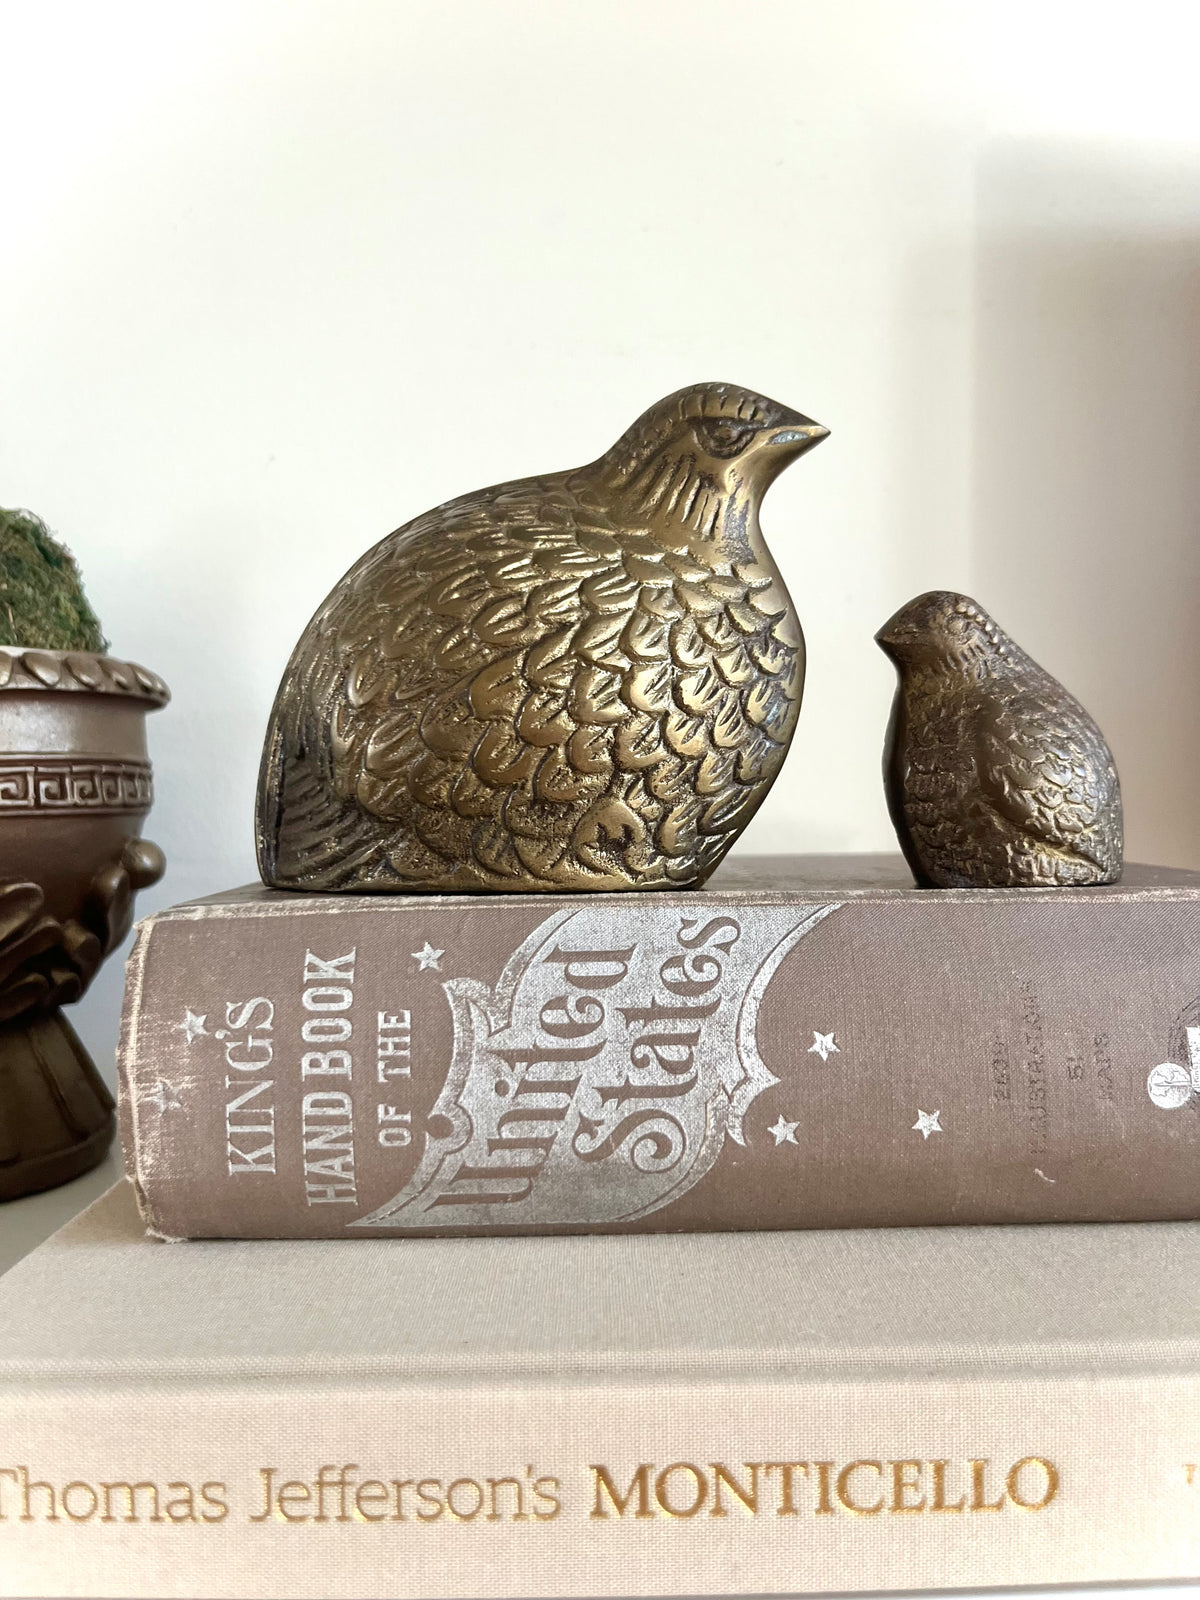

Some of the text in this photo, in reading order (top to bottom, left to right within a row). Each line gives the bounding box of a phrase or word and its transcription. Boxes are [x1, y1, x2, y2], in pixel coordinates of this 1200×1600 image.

[215, 996, 276, 1176] KING'S
[301, 946, 358, 1207] HANDBOOK
[377, 1009, 413, 1147] OF THE
[423, 942, 638, 1213] United
[571, 915, 742, 1175] States
[248, 1463, 562, 1523] Jefferson's
[589, 1455, 1061, 1520] MONTICELLO
